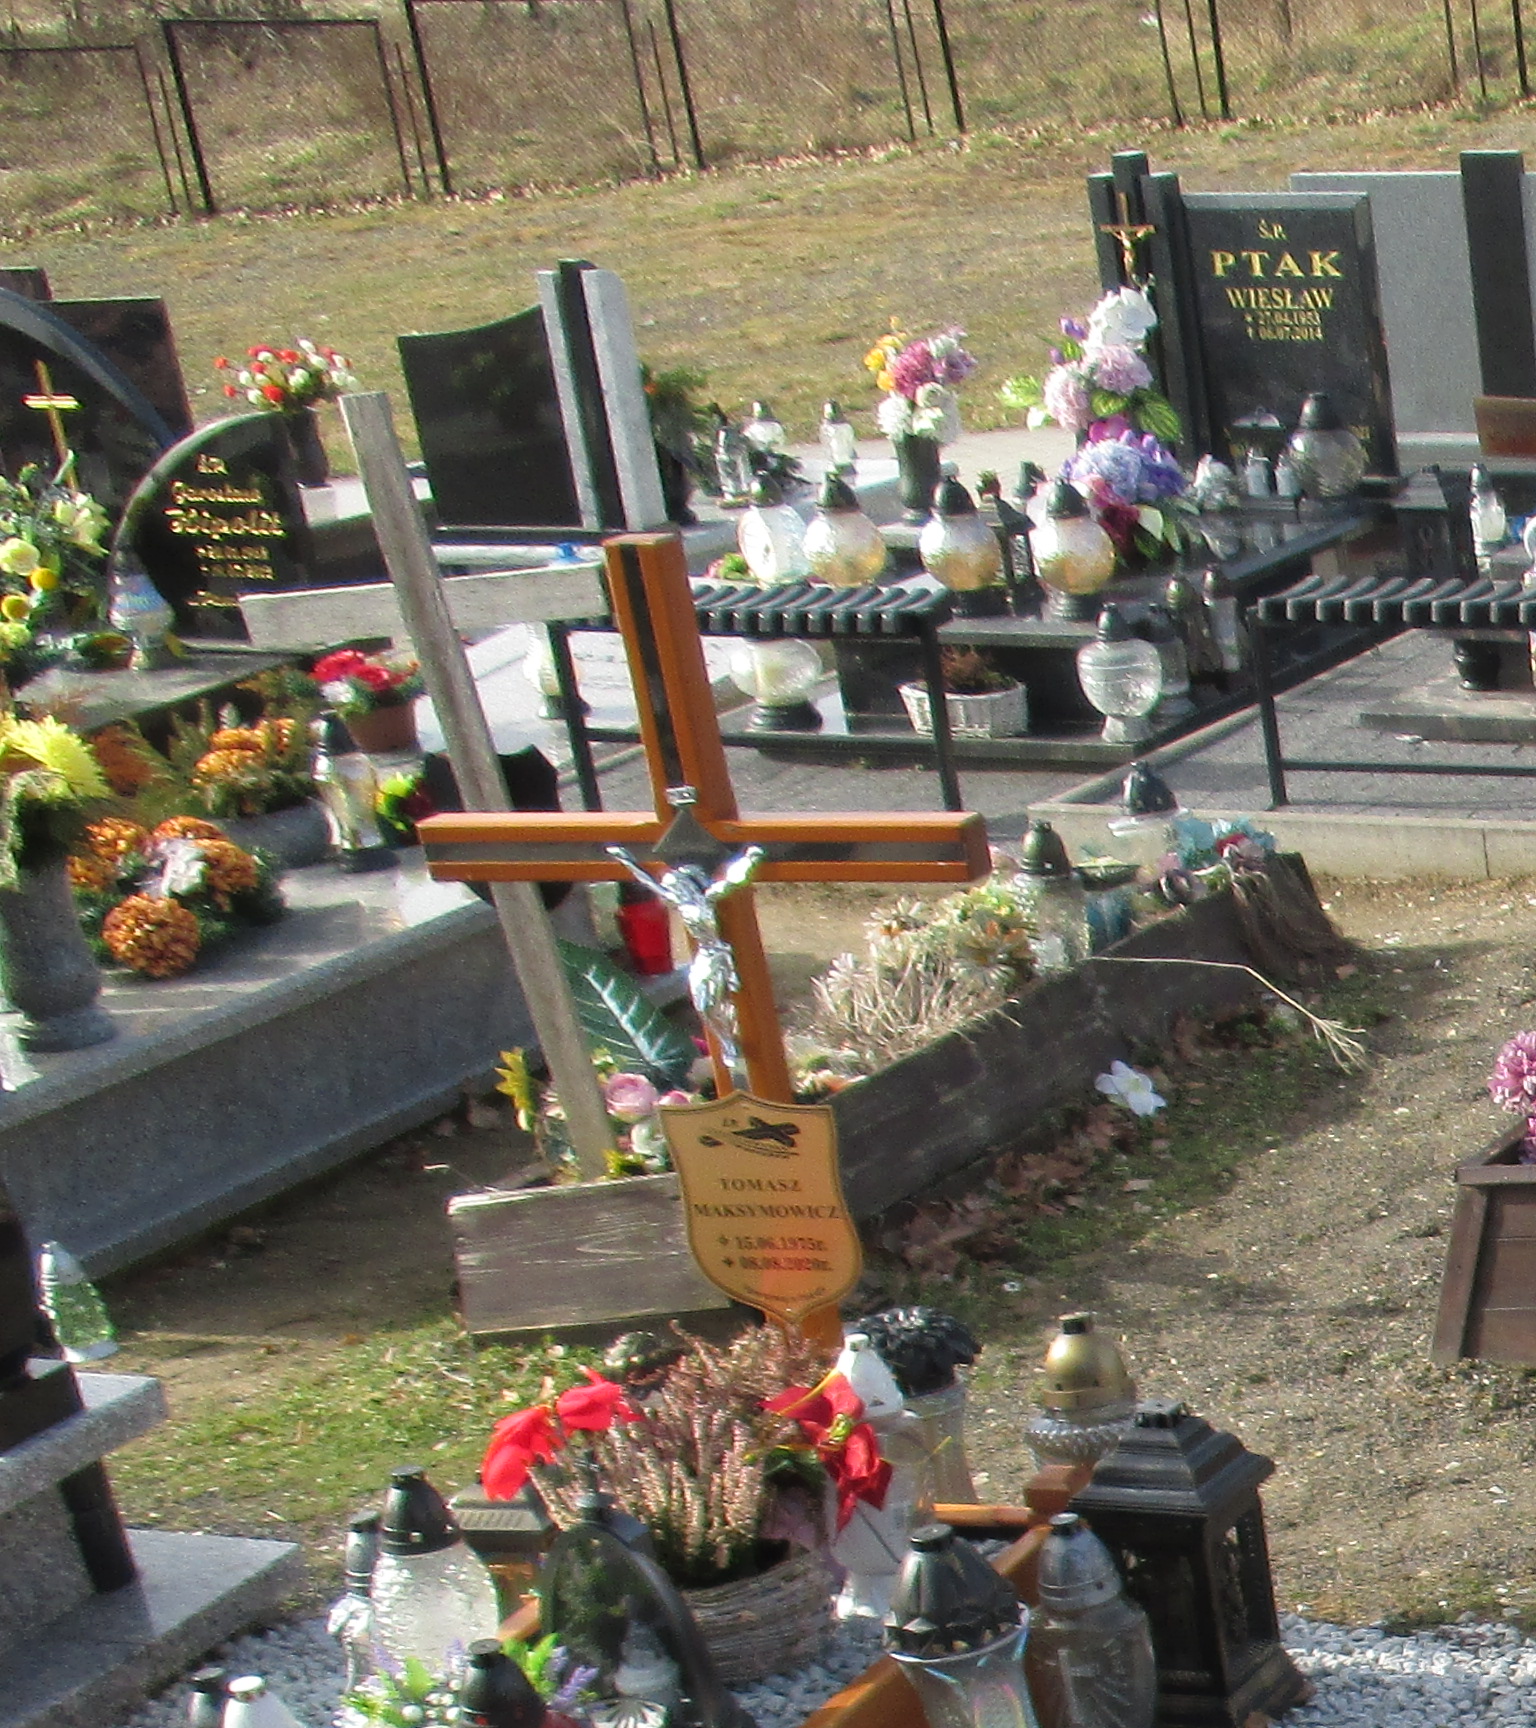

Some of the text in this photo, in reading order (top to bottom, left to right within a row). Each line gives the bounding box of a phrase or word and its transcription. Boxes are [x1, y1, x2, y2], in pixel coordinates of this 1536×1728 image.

[1211, 250, 1344, 278] PTAK
[1225, 287, 1334, 310] WIESŁAW
[720, 1178, 802, 1192] TOMASZ
[693, 1203, 841, 1219] MAKSYMOWICZ
